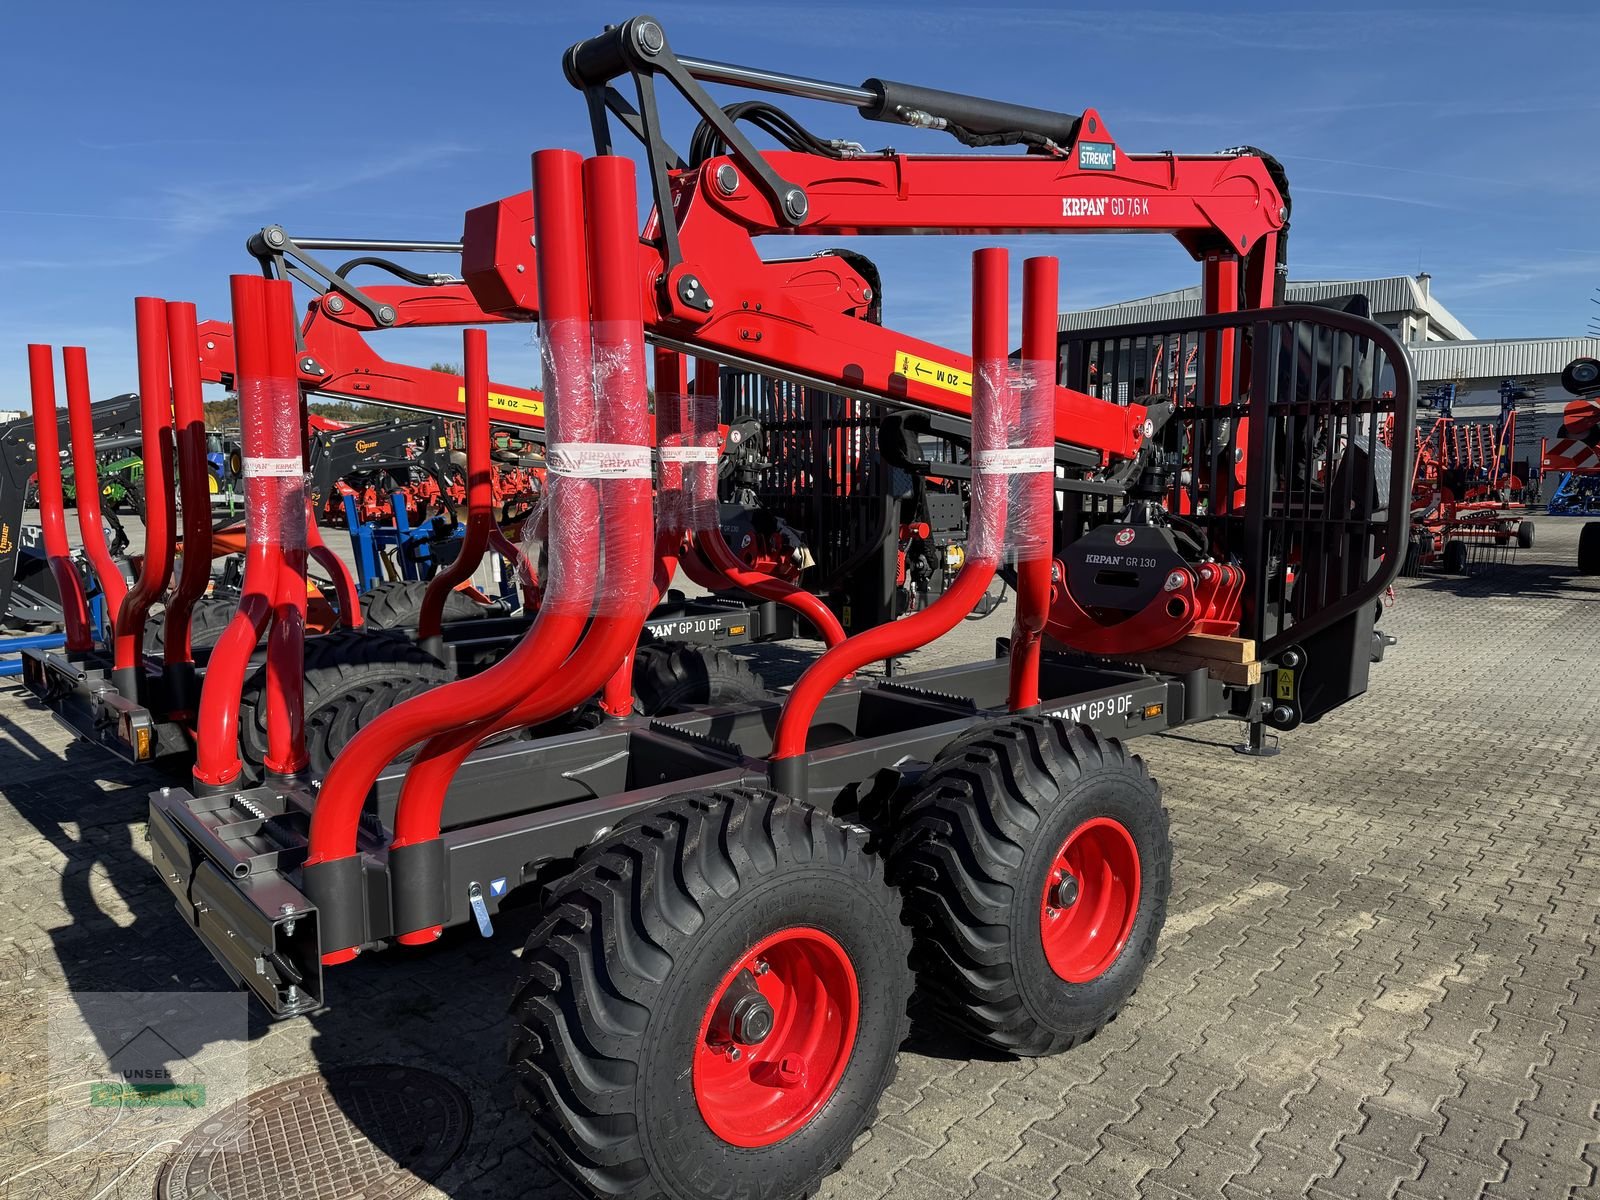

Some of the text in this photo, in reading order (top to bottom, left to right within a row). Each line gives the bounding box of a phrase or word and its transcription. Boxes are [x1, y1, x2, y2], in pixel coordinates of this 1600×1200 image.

[1081, 151, 1109, 165] STRENX
[1111, 198, 1125, 215] GD
[1127, 197, 1140, 217] 7,6
[1142, 198, 1149, 215] K
[947, 374, 959, 385] 20
[1125, 557, 1138, 566] GR
[1139, 558, 1156, 568] 130
[647, 619, 721, 637] PAN GP 10 DF
[1089, 701, 1105, 720] GP
[1107, 699, 1115, 715] 9
[1117, 694, 1133, 713] DF
